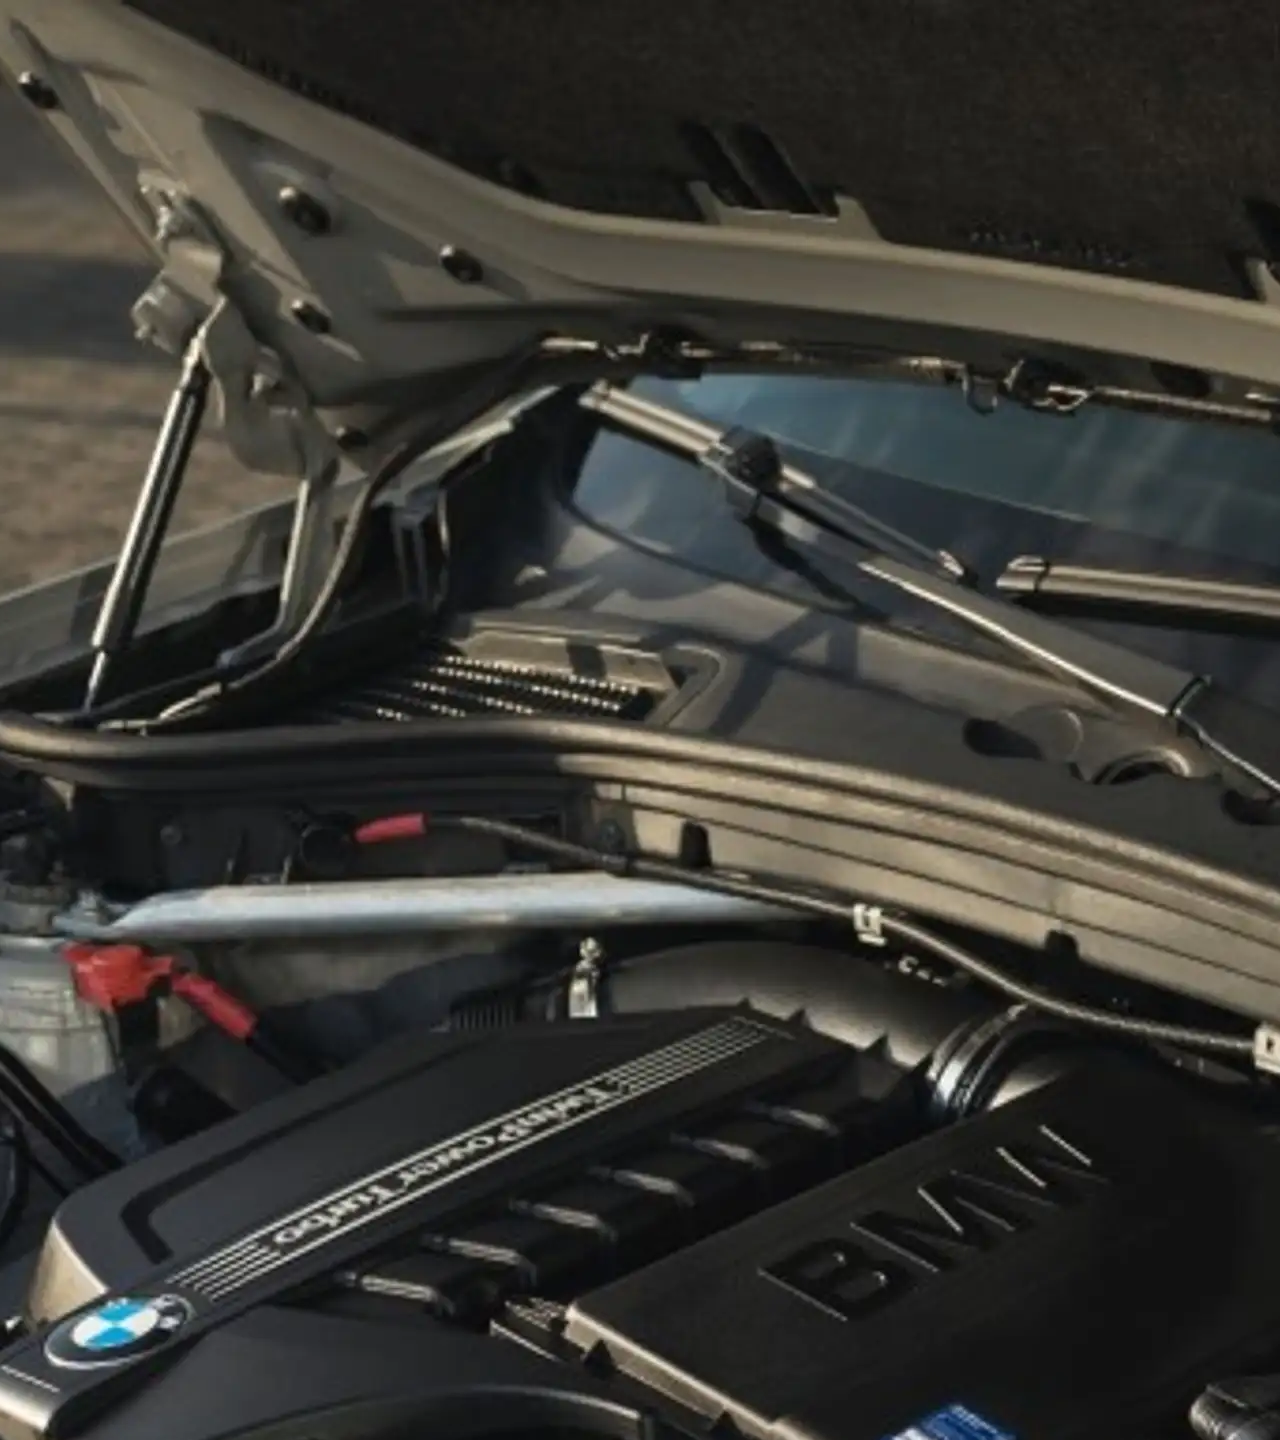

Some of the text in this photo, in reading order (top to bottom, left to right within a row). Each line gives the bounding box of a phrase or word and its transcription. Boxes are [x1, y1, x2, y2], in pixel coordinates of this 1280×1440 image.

[273, 1087, 617, 1244] TwinPower Turbo
[756, 1122, 1110, 1323] BMW
